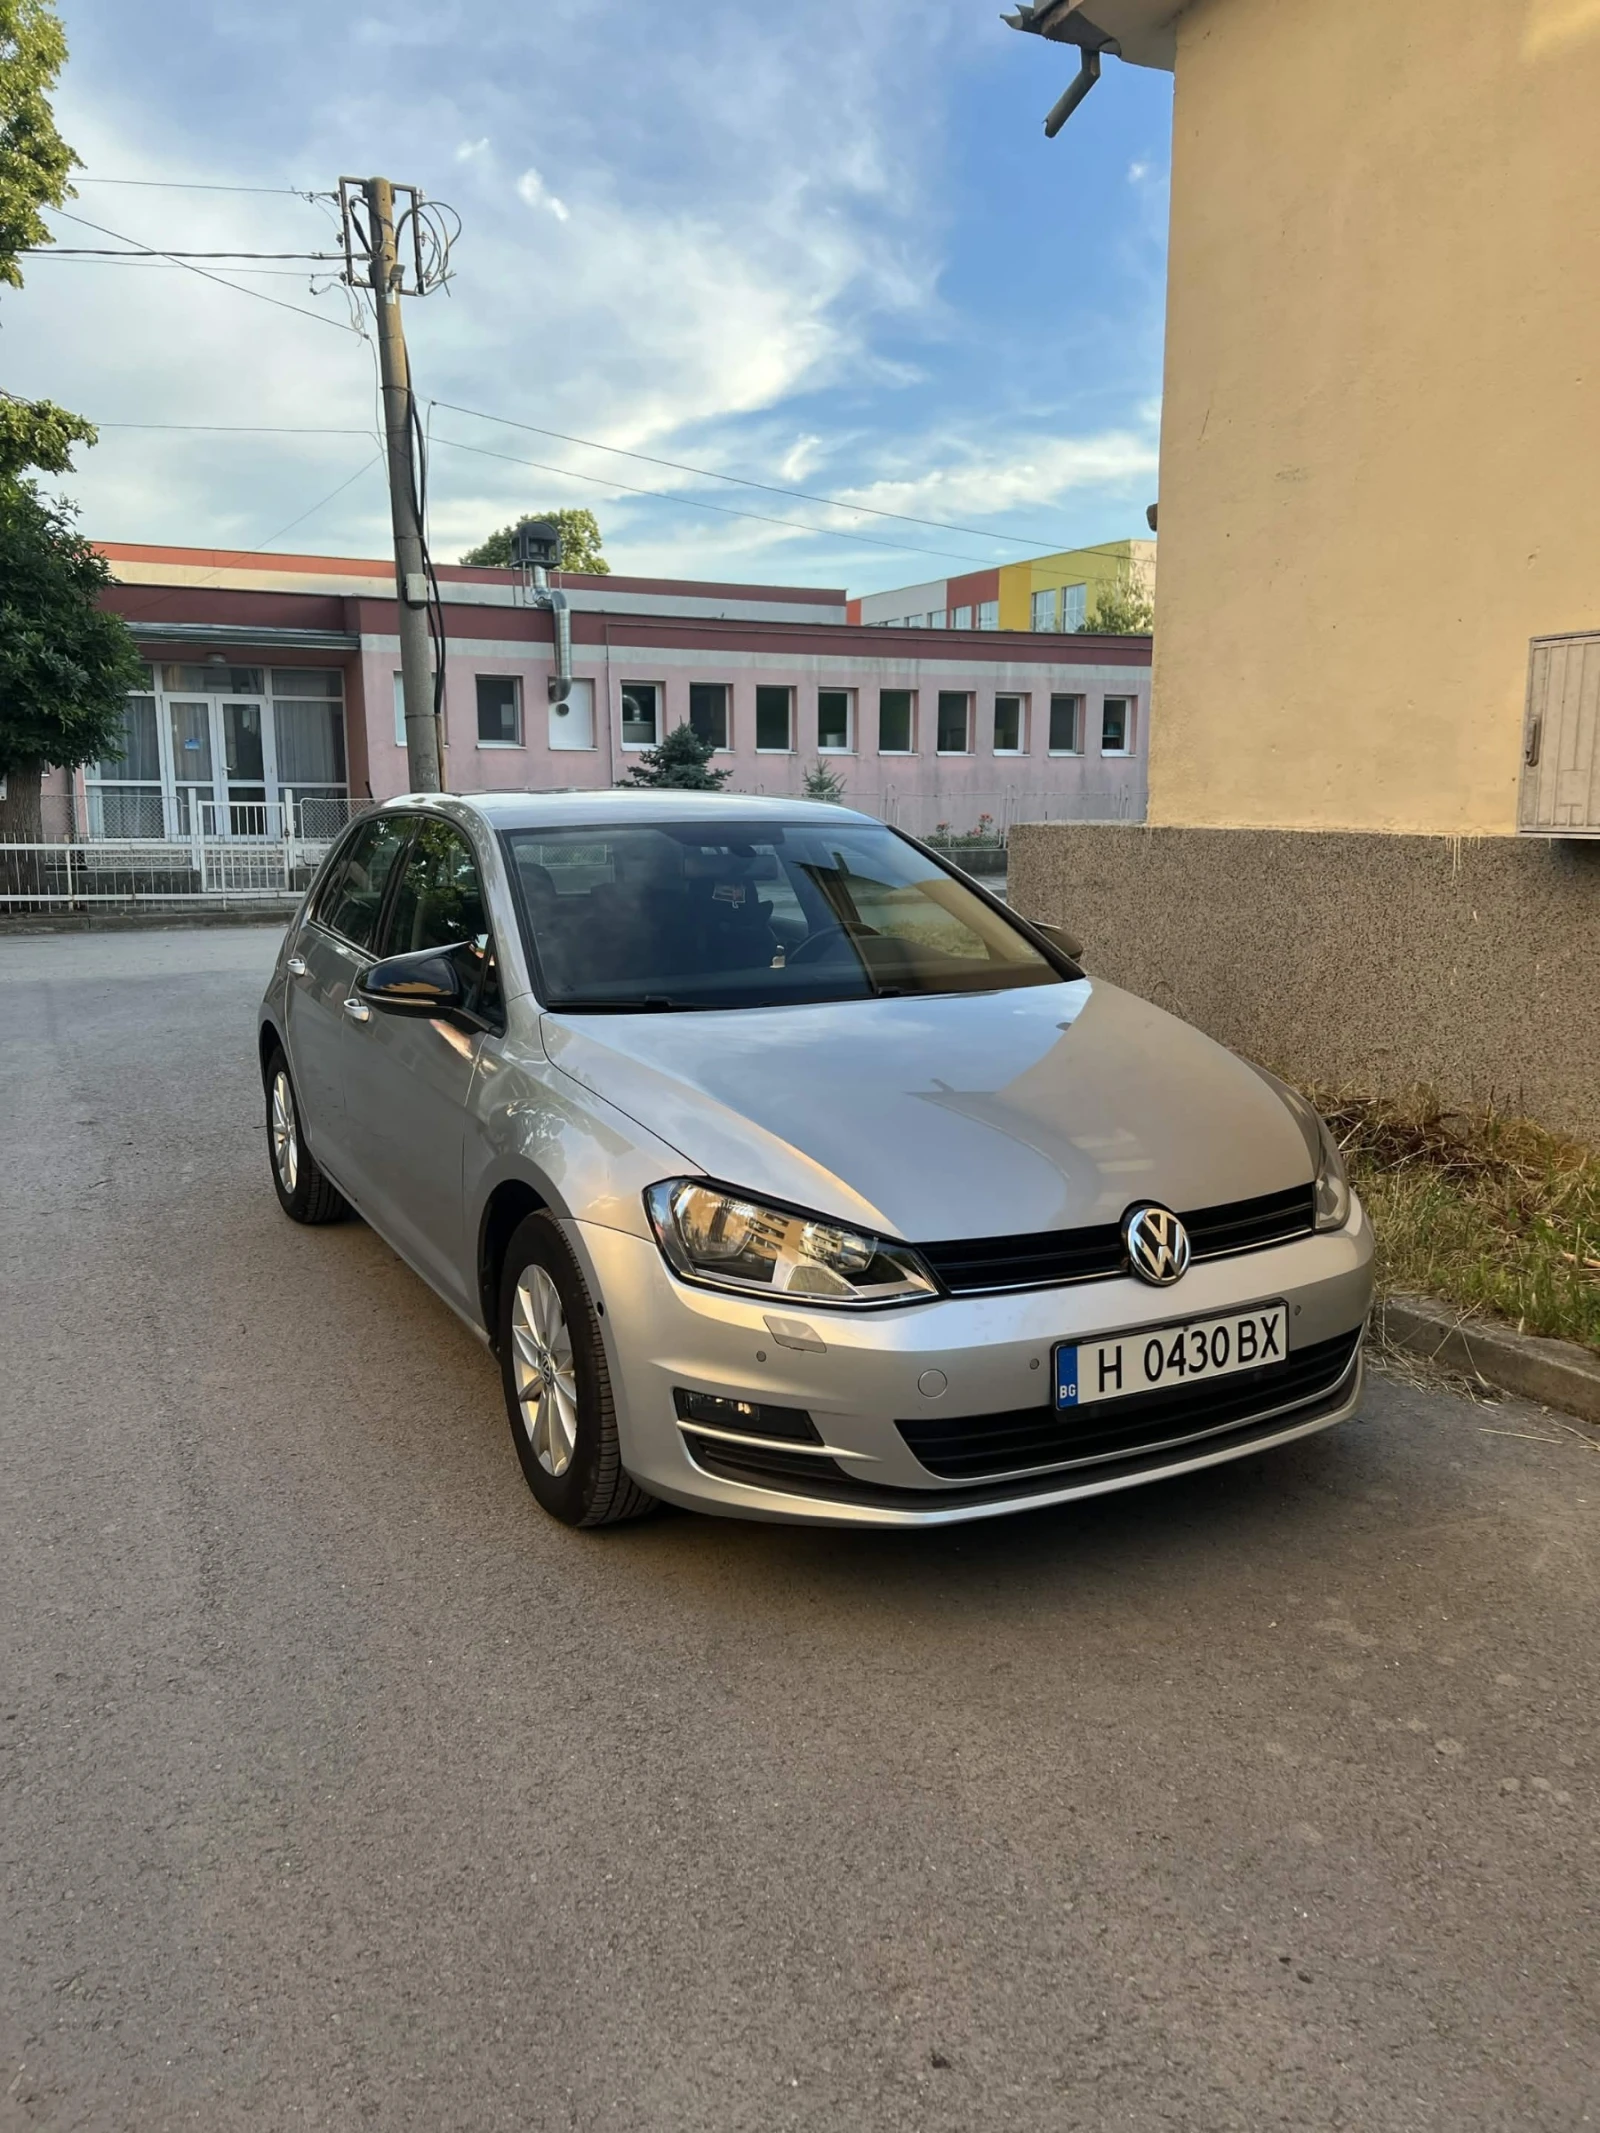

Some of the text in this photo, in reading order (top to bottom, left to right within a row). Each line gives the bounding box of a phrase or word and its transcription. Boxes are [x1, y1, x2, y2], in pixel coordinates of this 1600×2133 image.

[1129, 1208, 1190, 1281] VW
[1098, 1314, 1279, 1392] H 0430 BX
[1060, 1384, 1076, 1399] BG
